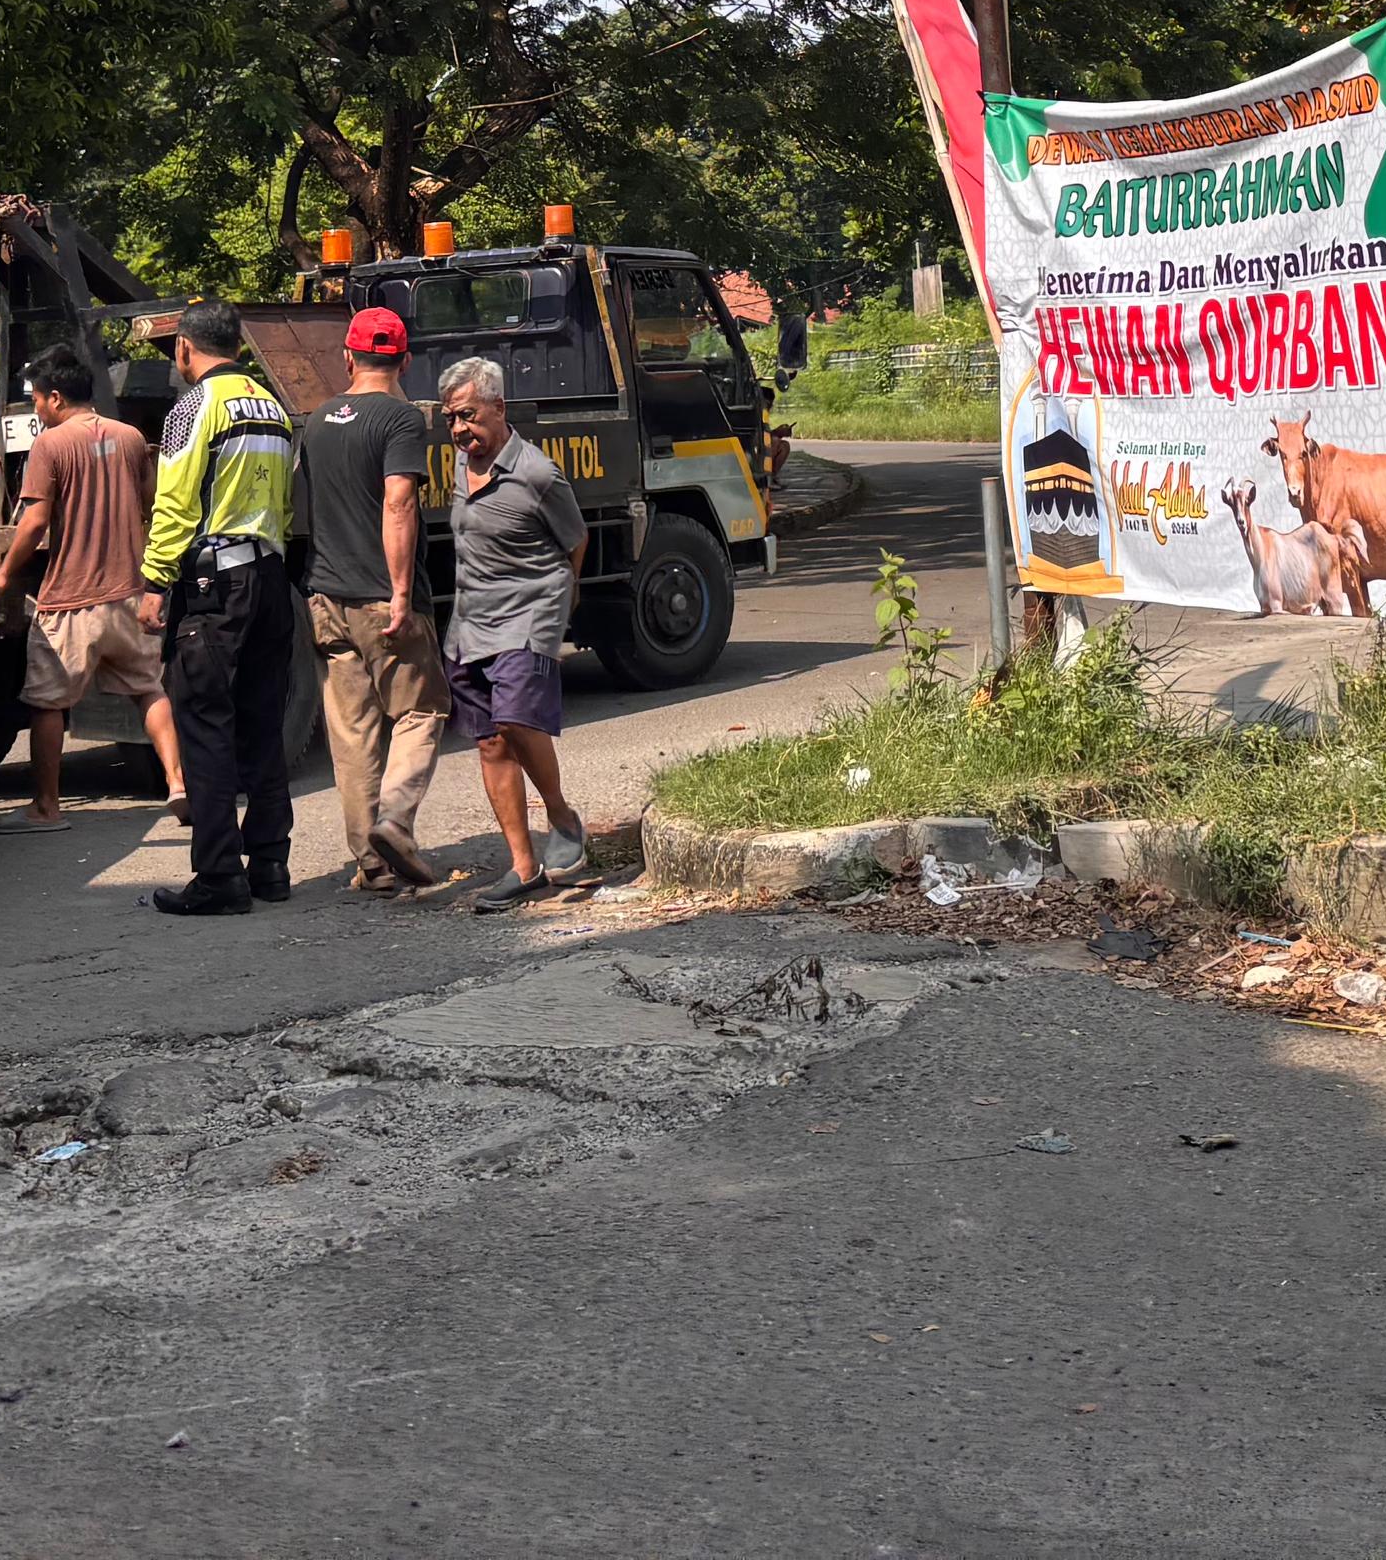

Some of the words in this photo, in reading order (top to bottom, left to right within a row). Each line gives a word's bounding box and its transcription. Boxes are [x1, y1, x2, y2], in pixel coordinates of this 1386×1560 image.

[1026, 131, 1113, 166] DEWAN
[1106, 101, 1291, 159] KEMAKMURAN
[1282, 72, 1379, 130] MASJID
[1055, 140, 1345, 238] BAITURRAHMAN
[1159, 260, 1206, 292] Dan
[1035, 302, 1193, 398] HEWAN
[5, 420, 16, 439] E
[1116, 441, 1158, 455] Selamat
[1160, 442, 1181, 456] Hari
[1183, 442, 1207, 459] Raya
[569, 435, 605, 479] TOL
